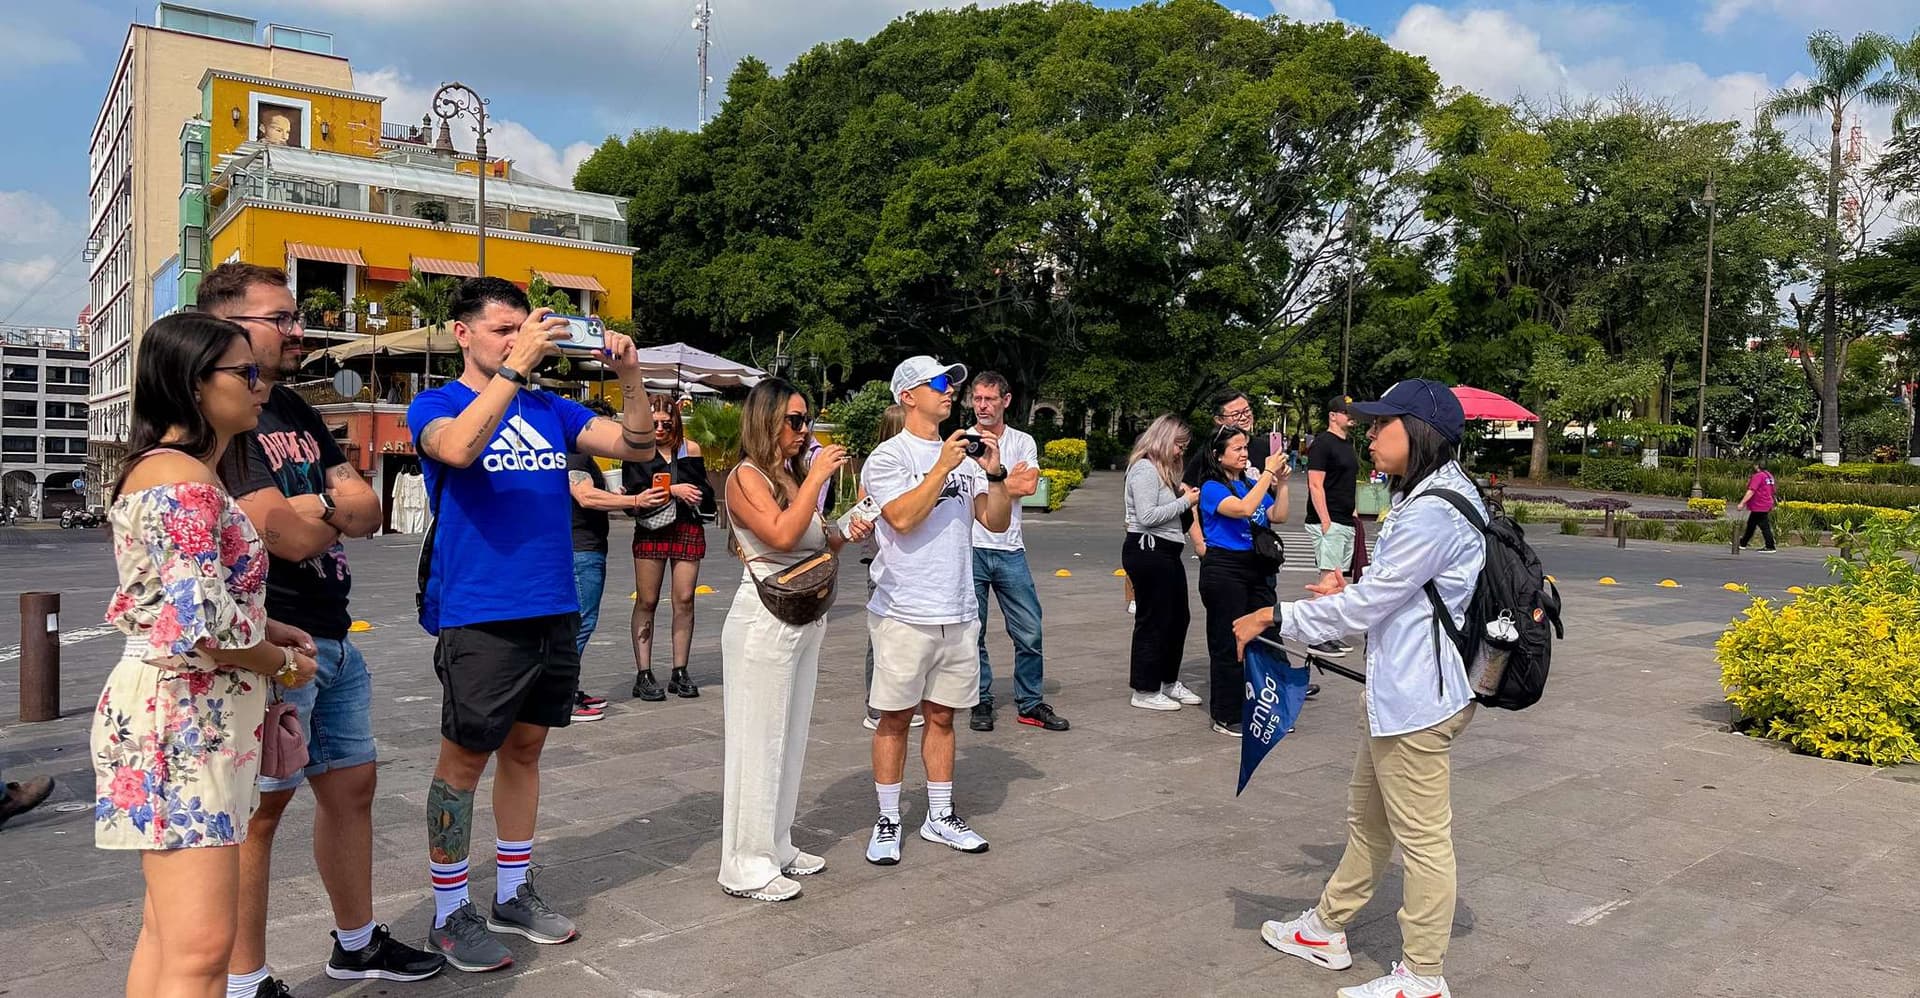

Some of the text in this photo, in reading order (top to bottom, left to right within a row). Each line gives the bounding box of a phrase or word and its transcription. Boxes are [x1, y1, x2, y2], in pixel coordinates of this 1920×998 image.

[483, 449, 567, 472] adidas
[1250, 676, 1279, 738] amigo
[1261, 714, 1280, 744] tours
